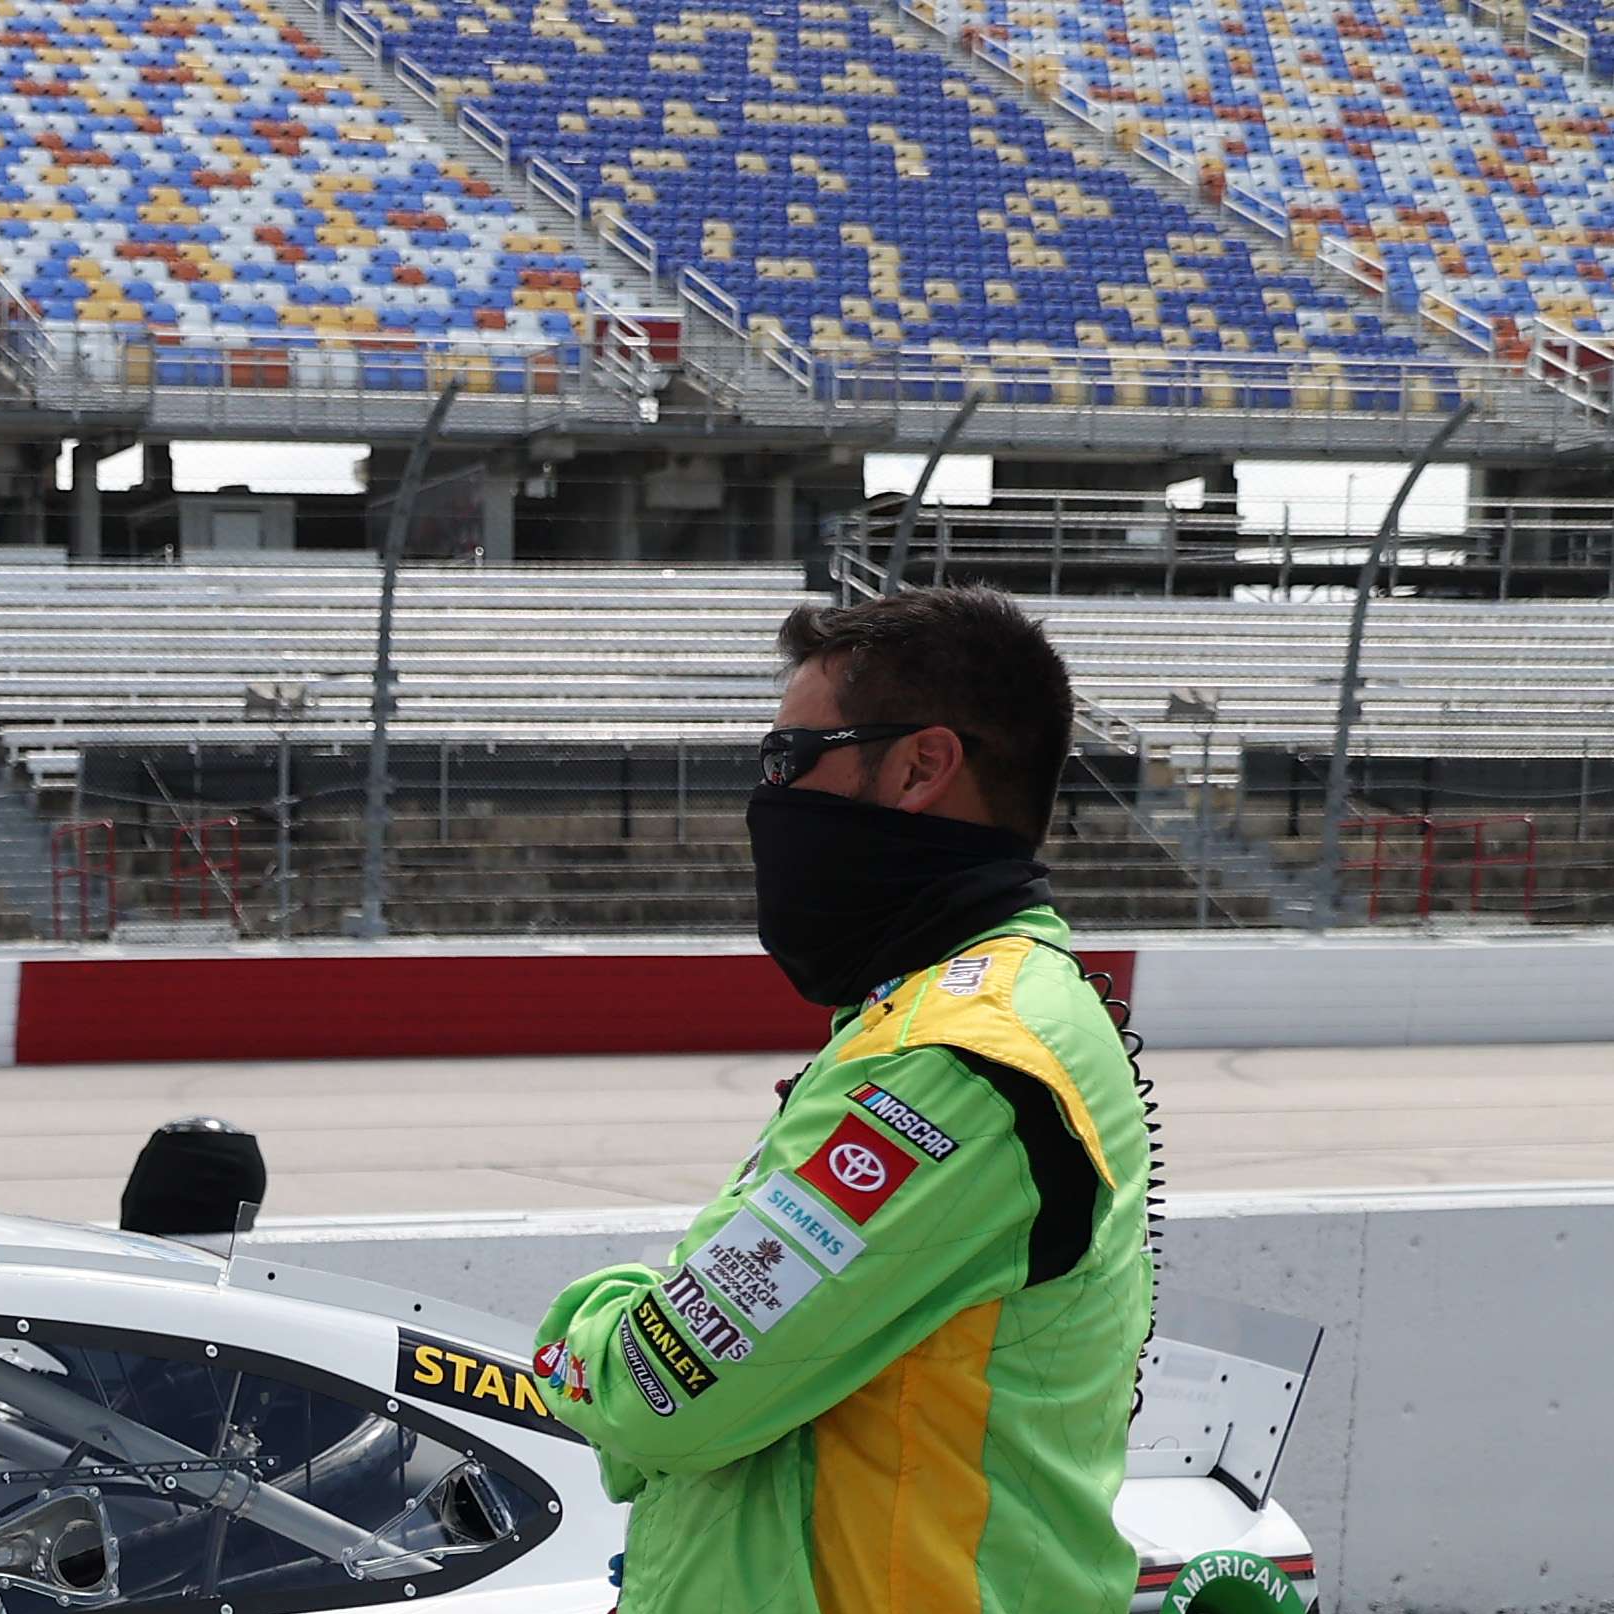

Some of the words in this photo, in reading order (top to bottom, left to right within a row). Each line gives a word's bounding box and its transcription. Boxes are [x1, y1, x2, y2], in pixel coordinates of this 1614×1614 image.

[871, 1095, 954, 1158] NASCAR
[768, 1189, 844, 1256] SIEMENS
[708, 1244, 780, 1311] HERITAGE
[725, 1246, 779, 1293] AMERICAN
[413, 1344, 548, 1417] STAN
